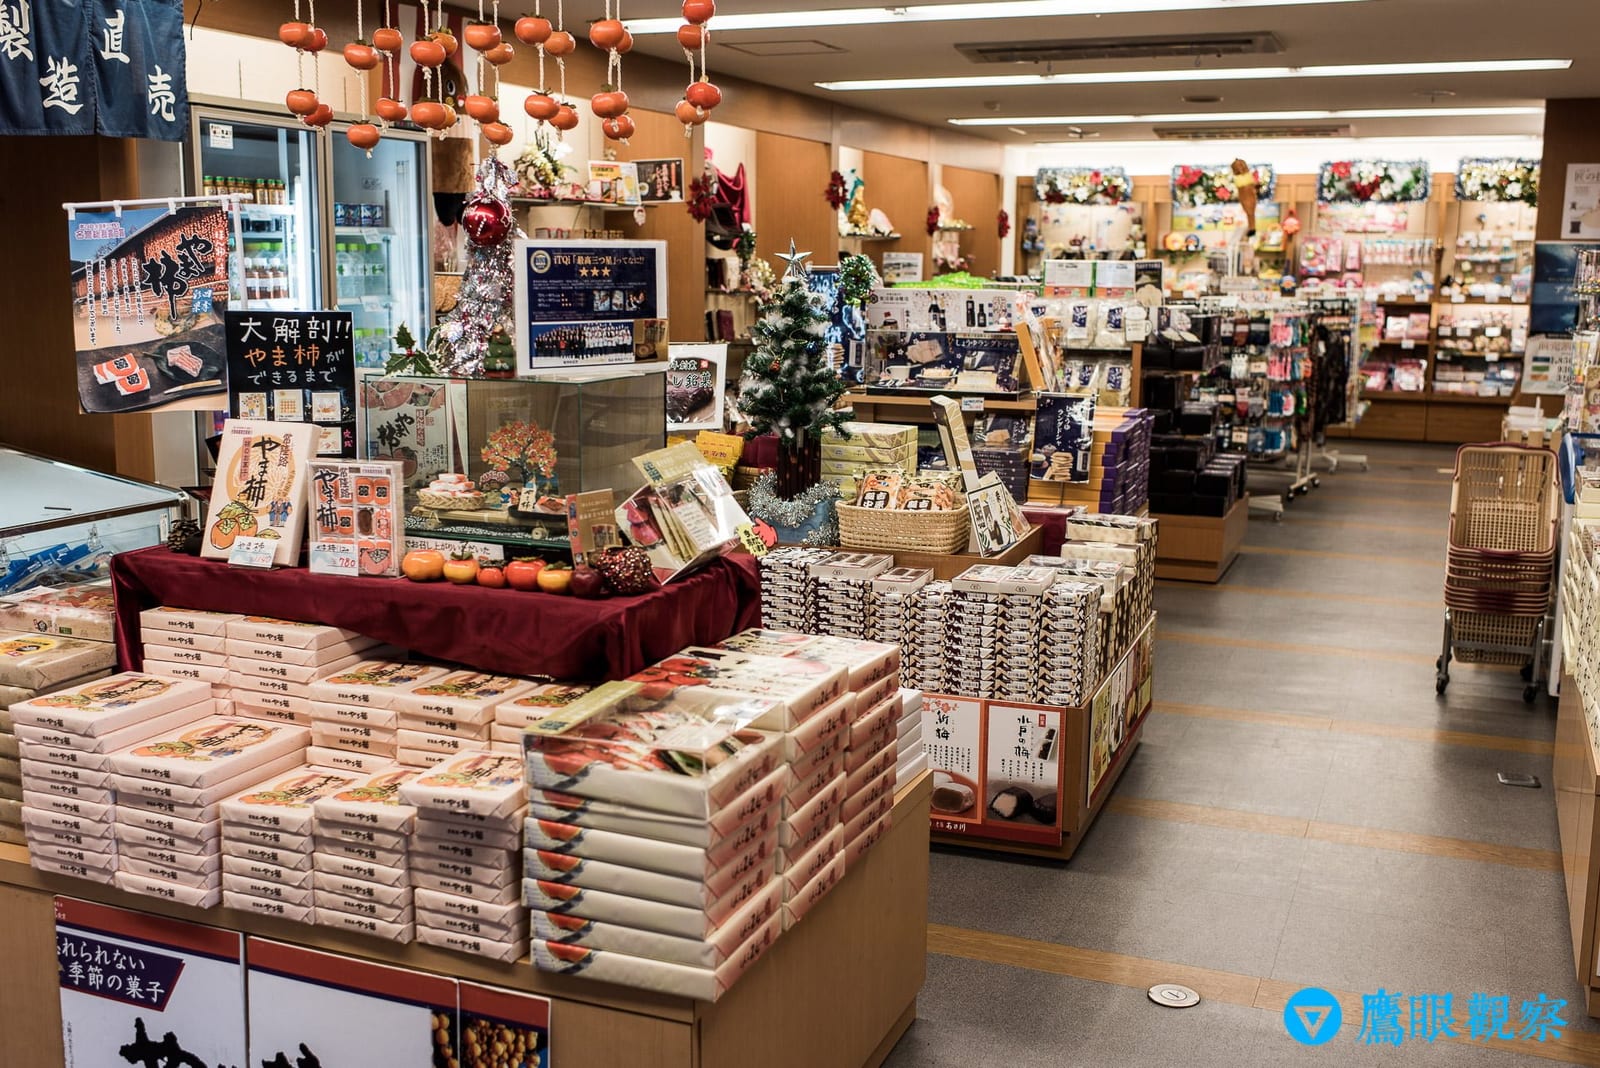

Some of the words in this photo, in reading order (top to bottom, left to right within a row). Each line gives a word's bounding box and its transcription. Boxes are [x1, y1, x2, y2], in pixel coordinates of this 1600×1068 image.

[244, 344, 345, 368] やま柿が
[247, 367, 337, 385] できるまで
[237, 435, 281, 507] やま柿
[313, 468, 339, 532] やま柿
[339, 557, 356, 568] 780
[68, 961, 166, 1004] 季節の菓子
